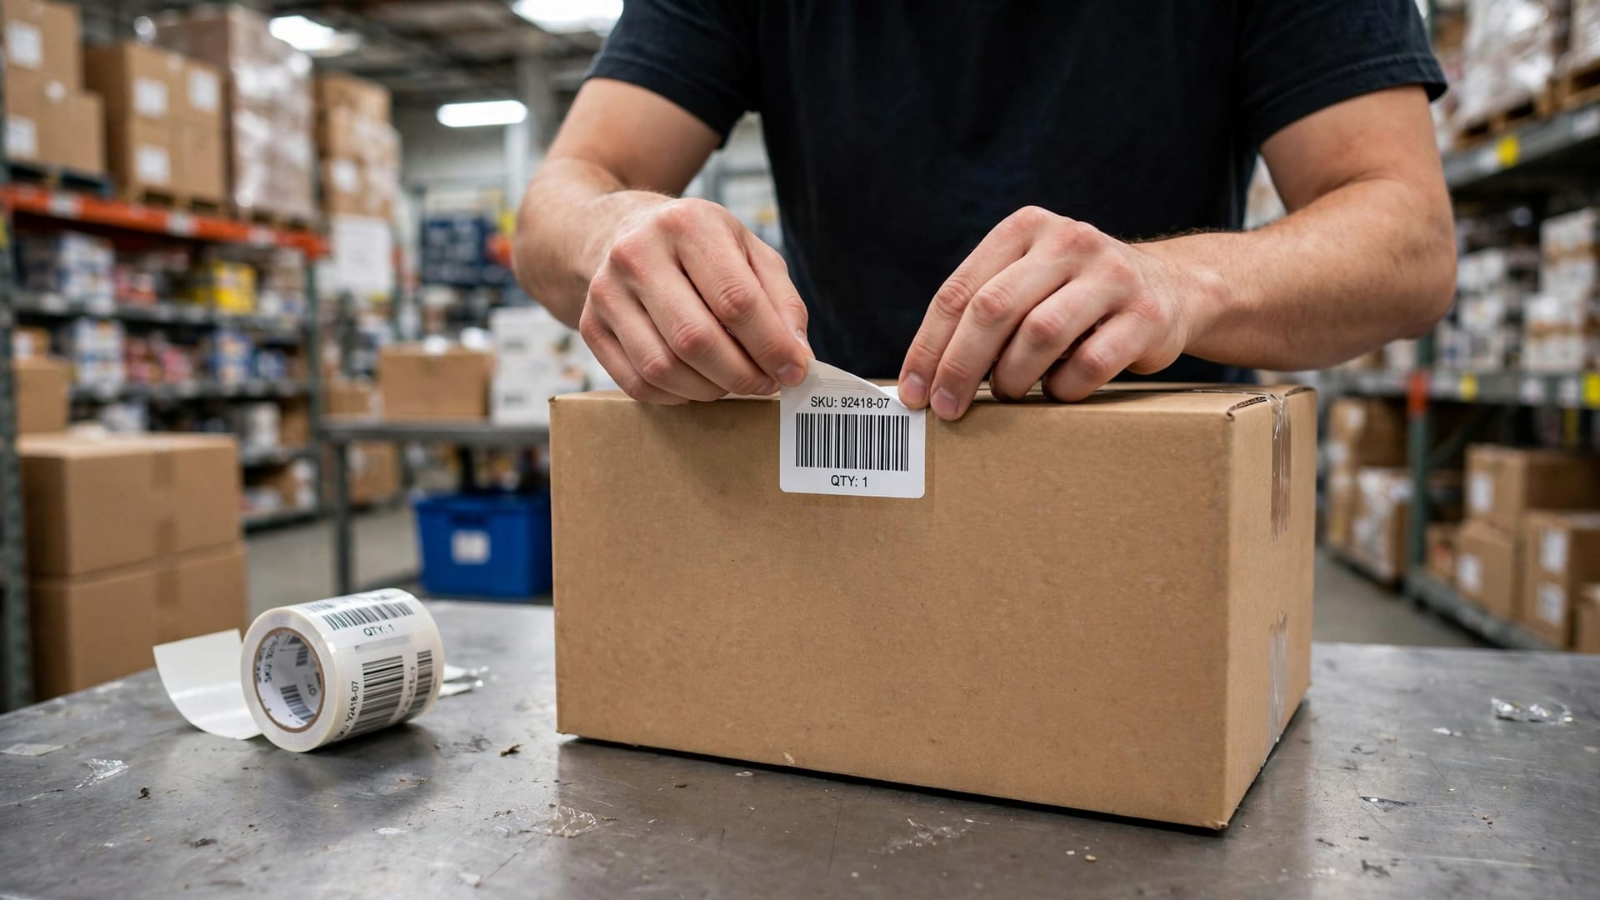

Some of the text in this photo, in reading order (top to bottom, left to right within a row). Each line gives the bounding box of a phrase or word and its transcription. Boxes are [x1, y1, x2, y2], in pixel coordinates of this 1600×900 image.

[810, 396, 890, 409] SKU: 92418-07
[830, 475, 868, 487] QTY: 1
[363, 624, 395, 637] QTY: 1
